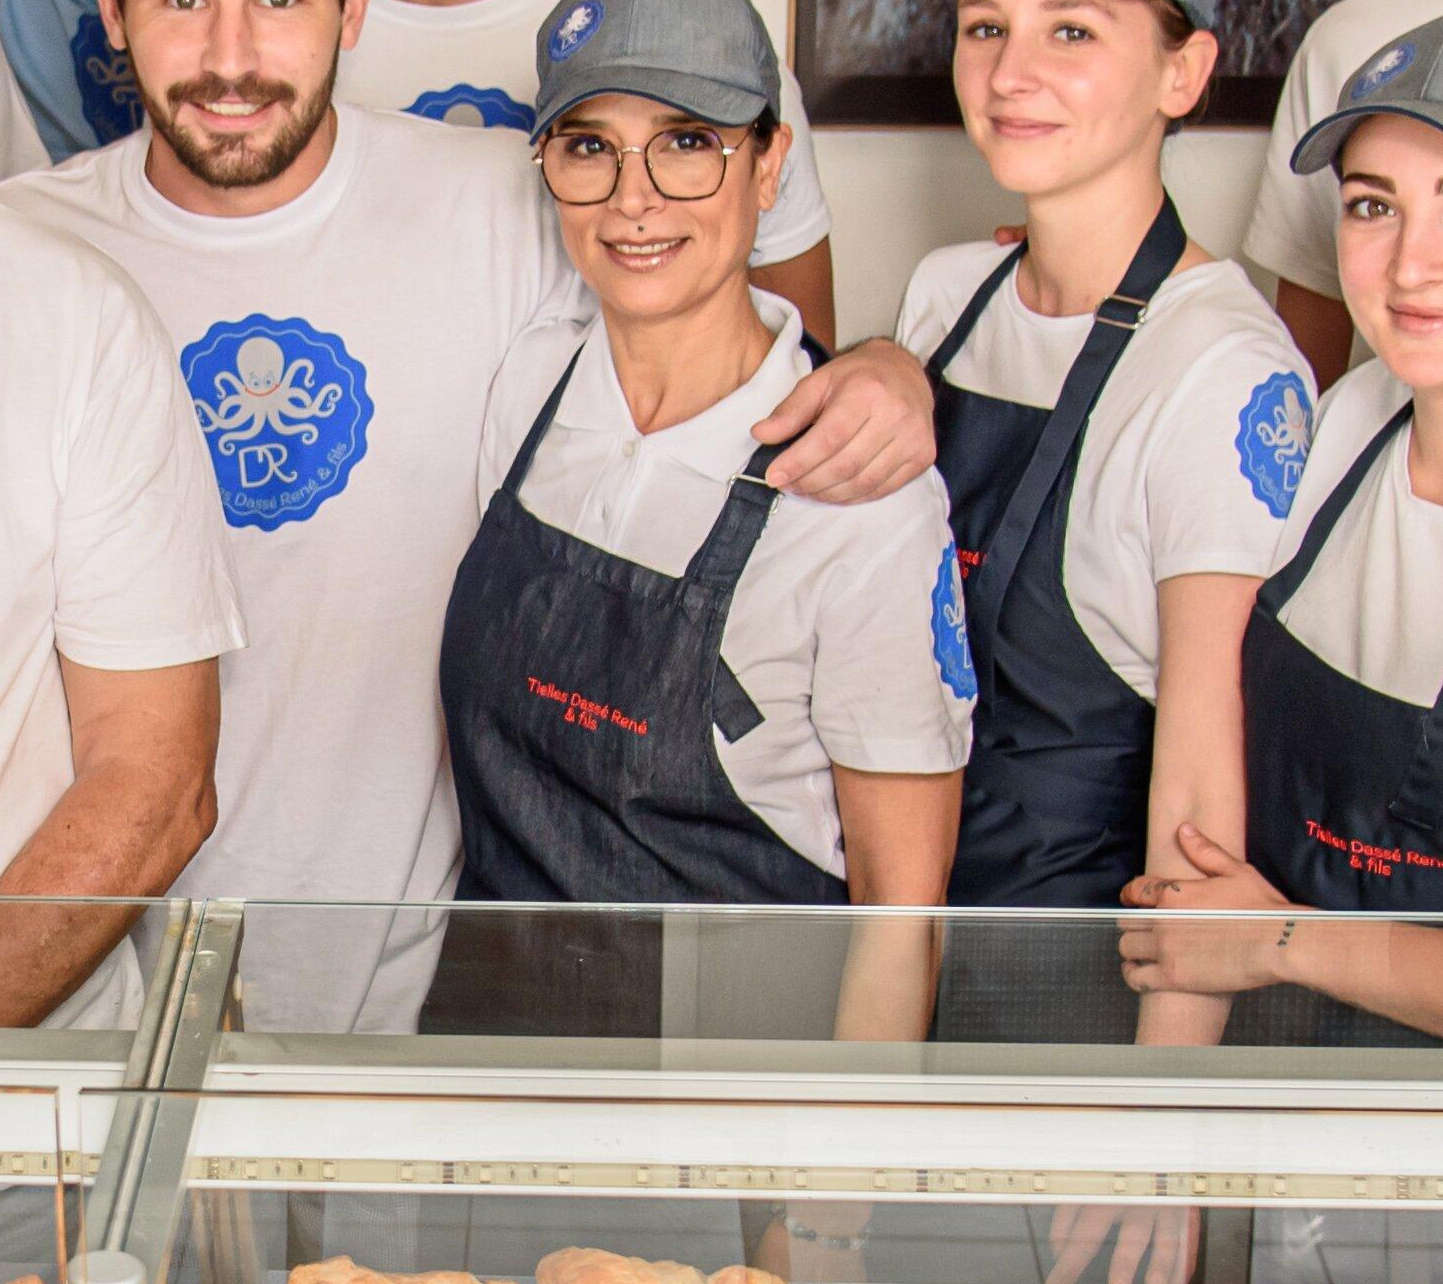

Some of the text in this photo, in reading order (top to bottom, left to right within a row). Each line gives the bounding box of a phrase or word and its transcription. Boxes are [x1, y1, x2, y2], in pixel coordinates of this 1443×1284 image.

[237, 443, 299, 489] DR
[527, 676, 648, 736] Tielles Dassé René
[564, 707, 598, 731] & fils
[1306, 820, 1348, 851] Tielles
[1350, 838, 1402, 863] Dassé
[1367, 858, 1393, 877] fils
